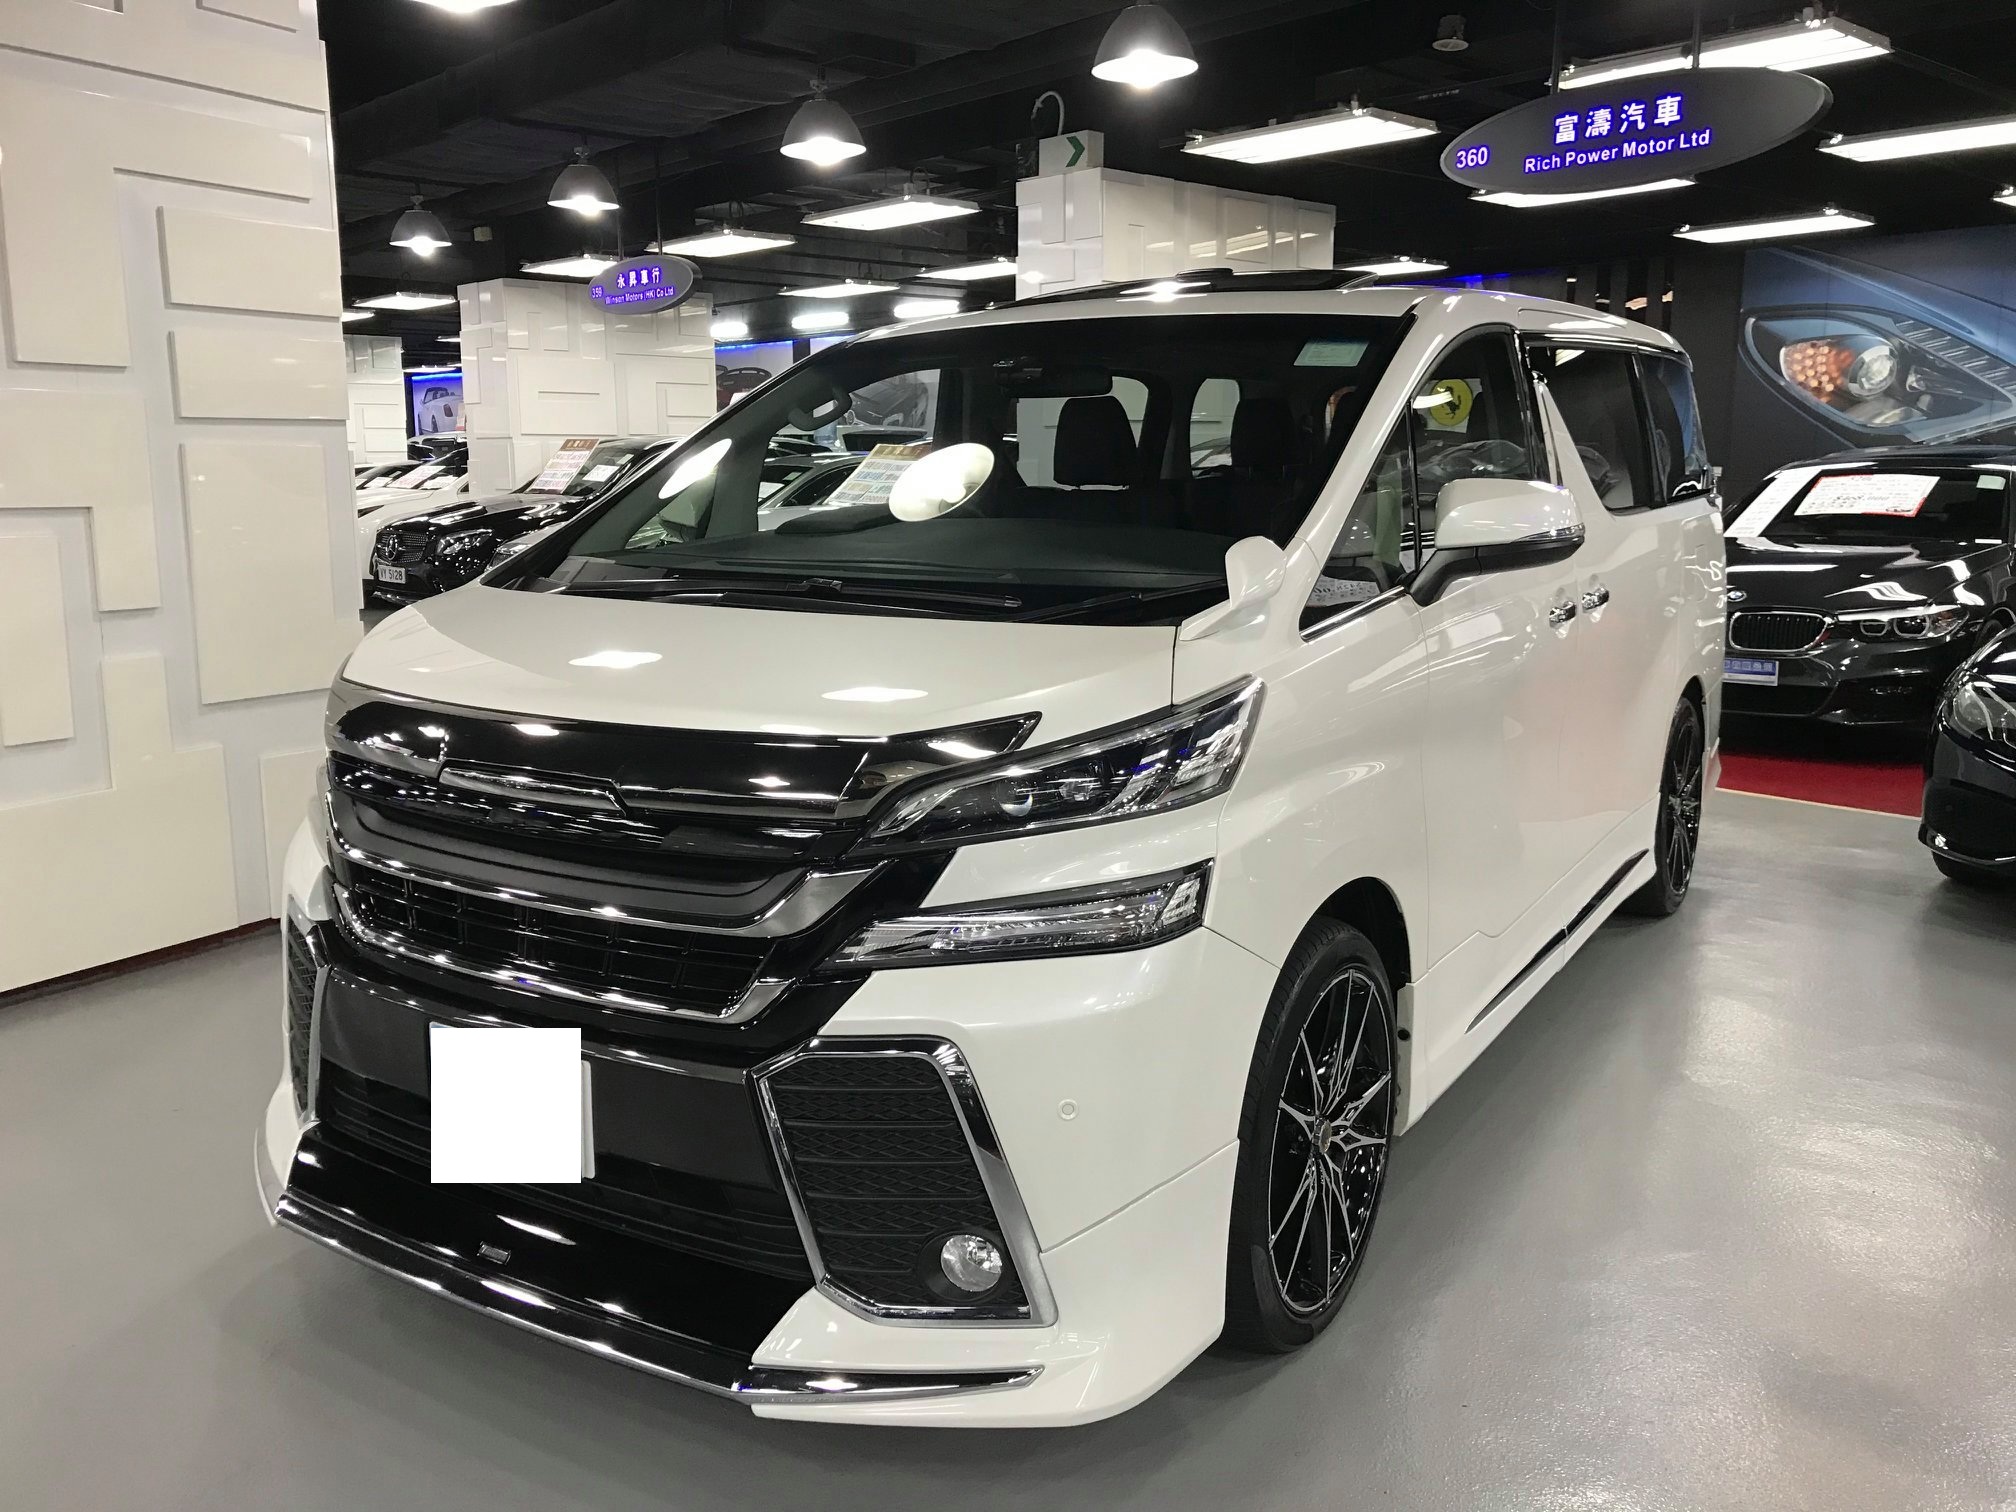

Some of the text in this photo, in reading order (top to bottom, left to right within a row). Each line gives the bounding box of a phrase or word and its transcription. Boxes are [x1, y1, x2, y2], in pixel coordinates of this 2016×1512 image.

[1555, 95, 1682, 144] 富濤汽車
[1456, 146, 1488, 168] 360
[1524, 129, 1710, 173] Rich Power Motor Ltd
[625, 292, 643, 302] Motors
[656, 288, 664, 297] Co
[664, 286, 674, 296] Ltd
[388, 568, 403, 580] 5128
